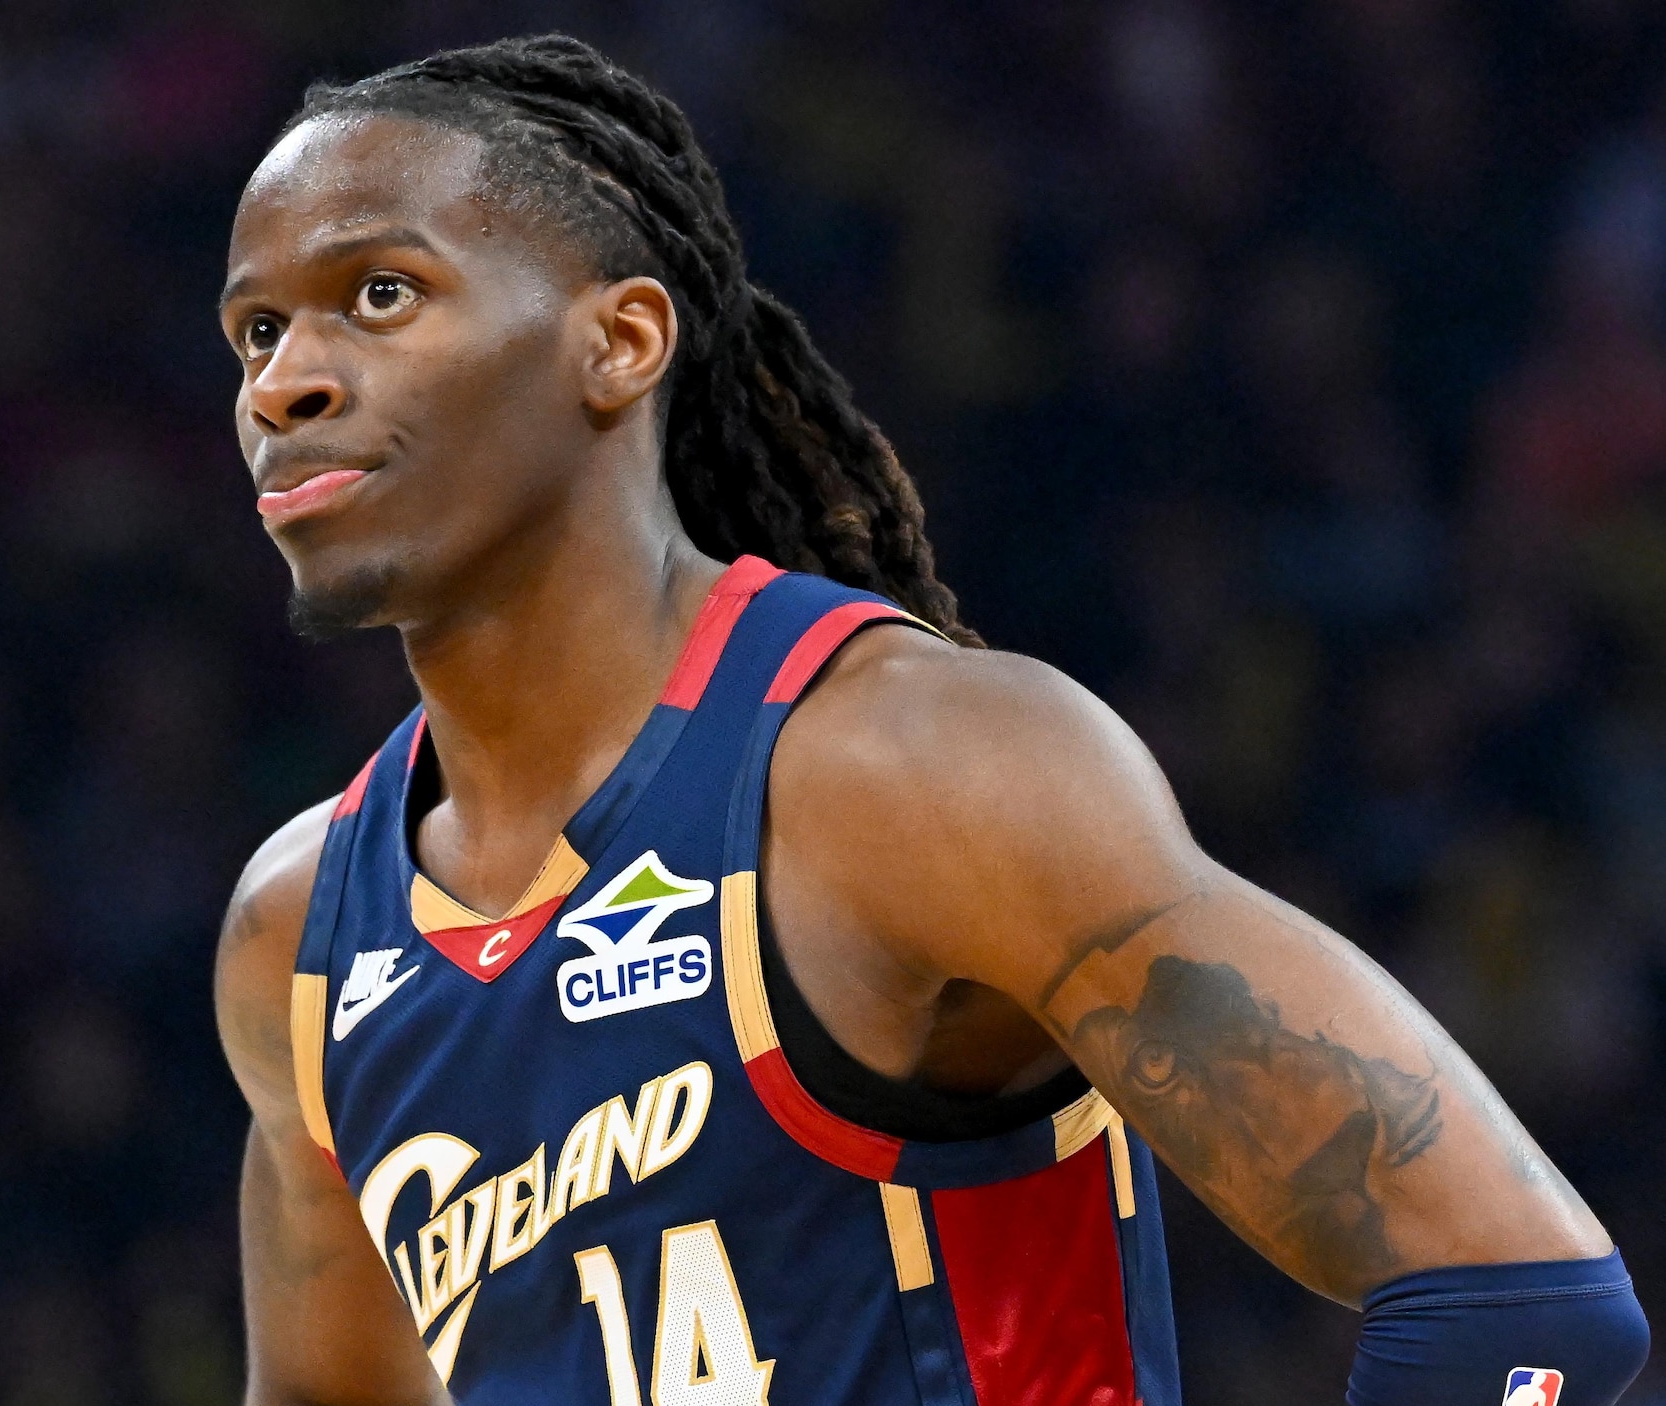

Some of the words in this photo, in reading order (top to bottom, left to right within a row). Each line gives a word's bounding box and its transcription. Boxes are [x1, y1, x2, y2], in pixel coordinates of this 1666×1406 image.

[478, 930, 512, 967] C
[565, 949, 707, 1008] CLIFFS
[359, 1060, 714, 1389] CLEVELAND
